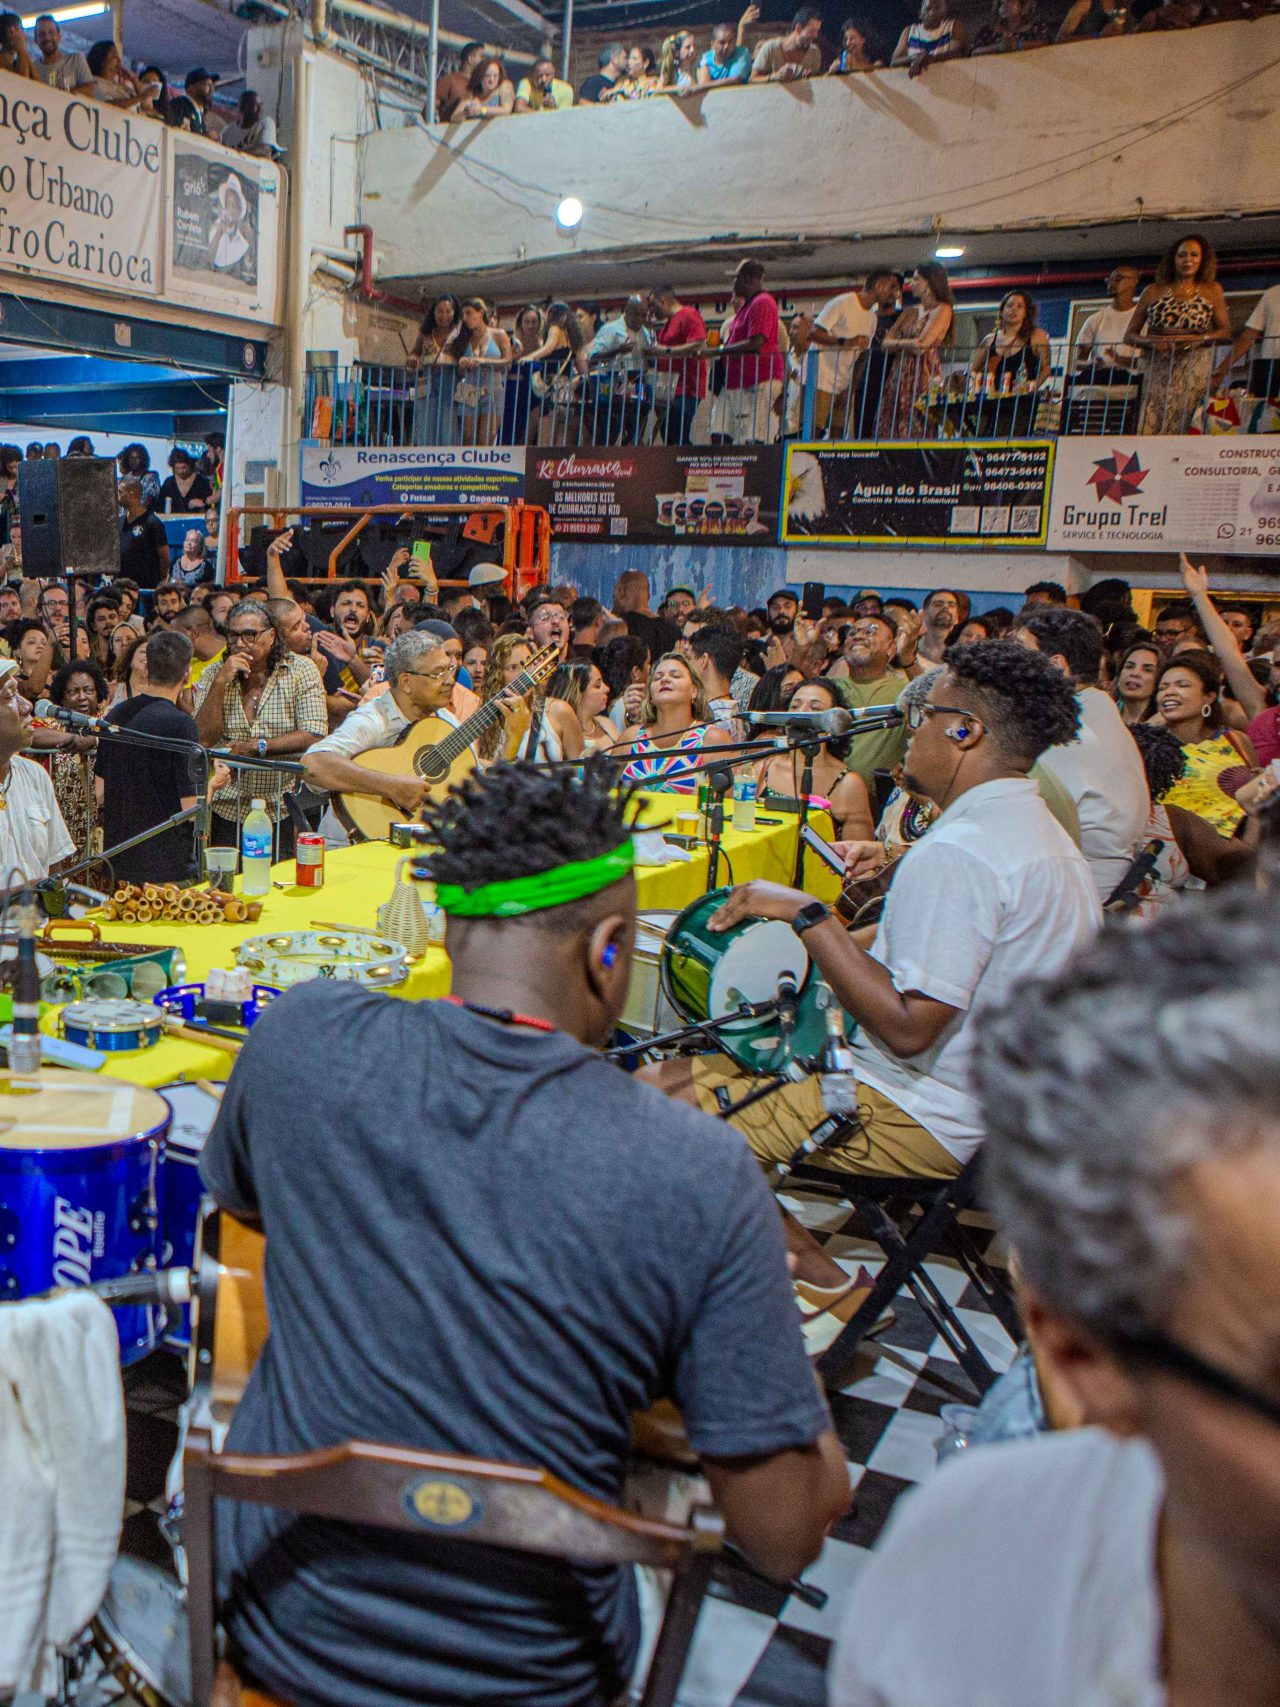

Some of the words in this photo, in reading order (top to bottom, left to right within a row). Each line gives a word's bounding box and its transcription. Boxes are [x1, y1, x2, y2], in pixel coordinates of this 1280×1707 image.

[64, 101, 160, 173] Clube
[24, 156, 114, 219] Urbano
[357, 450, 456, 466] Renascença
[462, 450, 511, 463] Clube
[836, 452, 850, 460] seja
[539, 460, 554, 478] Ki
[557, 453, 620, 478] Churrasco
[1184, 466, 1261, 476] CONSULTORIA,
[394, 475, 422, 484] participar
[392, 484, 423, 492] Categorias
[897, 484, 915, 496] do
[919, 484, 960, 496] Brasil
[1267, 483, 1274, 493] E
[409, 494, 436, 502] Futsal
[554, 492, 563, 503] OS
[564, 492, 599, 503] MELHORES
[599, 492, 615, 503] KITS
[894, 496, 915, 504] Toldos
[922, 496, 959, 504] Coberturas
[548, 503, 556, 515] DE
[557, 504, 596, 516] CHURRASCO
[608, 504, 621, 516] RIO
[1063, 505, 1121, 530] Grupo
[1127, 504, 1167, 526] Trel
[562, 523, 570, 533] 21
[1240, 527, 1252, 536] 21
[1062, 531, 1095, 540] SERVICE
[1098, 531, 1103, 539] E
[1107, 531, 1163, 540] TECNOLOGIA
